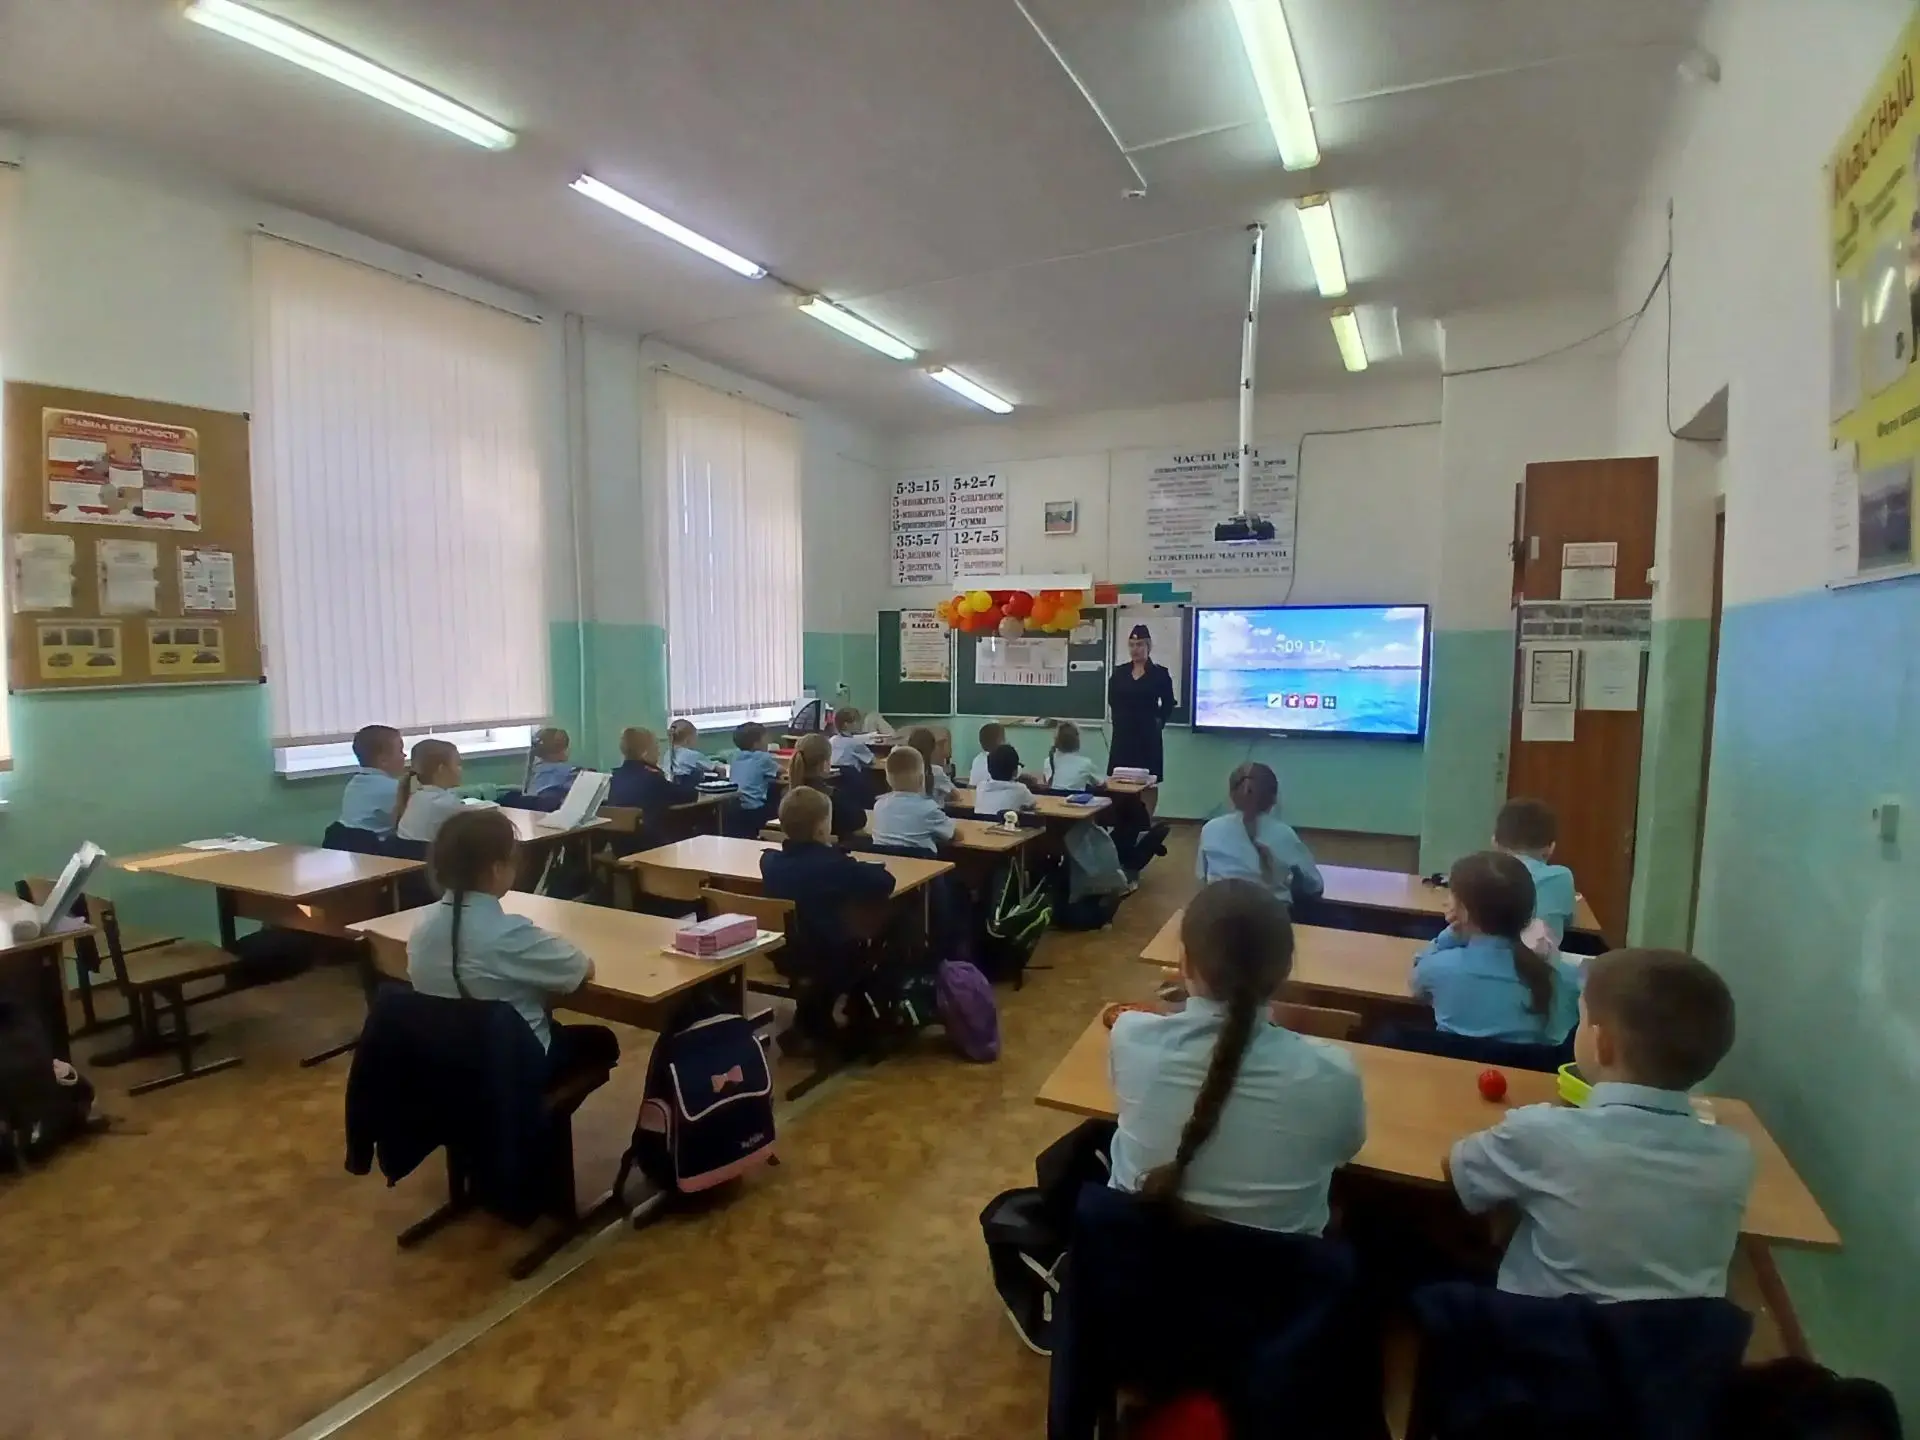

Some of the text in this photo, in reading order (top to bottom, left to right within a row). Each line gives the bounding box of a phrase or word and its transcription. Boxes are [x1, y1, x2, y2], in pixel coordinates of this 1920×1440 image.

[63, 417, 180, 439] ПРАВИЛА БЕЗОПАСНОСТИ
[1174, 453, 1216, 464] ЧАСТИ
[953, 475, 996, 490] 5+2=7
[896, 533, 940, 547] 35:5=7
[954, 530, 999, 544] 12-7=5
